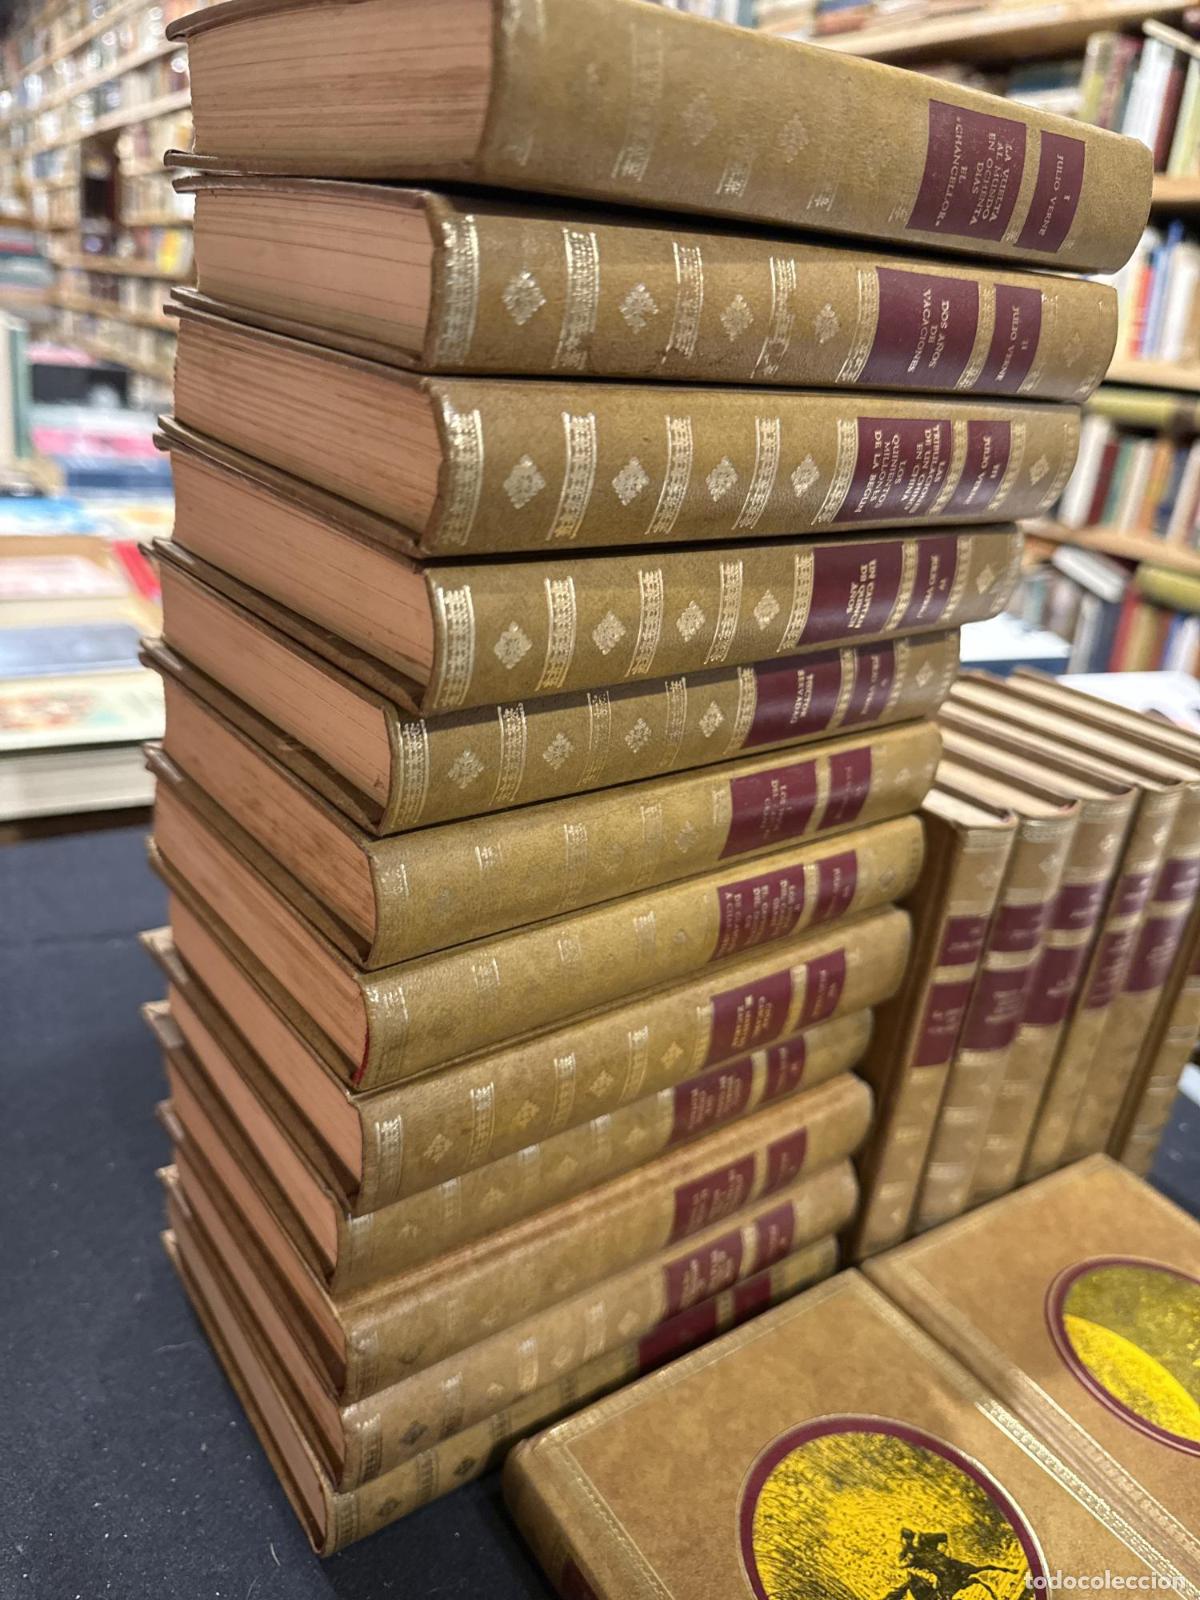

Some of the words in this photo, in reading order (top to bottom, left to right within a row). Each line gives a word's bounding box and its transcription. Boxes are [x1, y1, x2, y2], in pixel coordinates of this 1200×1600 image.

[988, 133, 997, 151] EN
[995, 141, 1004, 159] AL
[1004, 143, 1014, 161] LA
[959, 165, 968, 183] EL
[1053, 153, 1065, 191] JULIO
[969, 158, 993, 226] OCHENTA
[983, 164, 1001, 220] MUNDO
[989, 169, 1009, 222] VUELTA
[1038, 197, 1057, 237] VERNE
[940, 300, 950, 329] DOS
[1011, 306, 1020, 341] JULIO
[908, 288, 934, 373] VACACIONES
[928, 325, 938, 344] DE
[929, 335, 945, 369] AÑOS
[995, 345, 1015, 381] VERNE
[874, 430, 882, 448] DE
[916, 444, 923, 460] EN
[924, 429, 932, 446] DE
[981, 435, 991, 470] JULIO
[870, 442, 891, 502] MILLONES
[872, 453, 881, 470] LA
[873, 434, 901, 509] QUINIENTOS
[894, 460, 907, 485] LOS
[922, 449, 931, 469] UN
[934, 461, 946, 483] LAS
[901, 465, 919, 502] CHINA
[904, 474, 925, 511] CHINO
[860, 564, 868, 582] DE
[868, 559, 877, 579] UN
[848, 584, 866, 628] QUINCE
